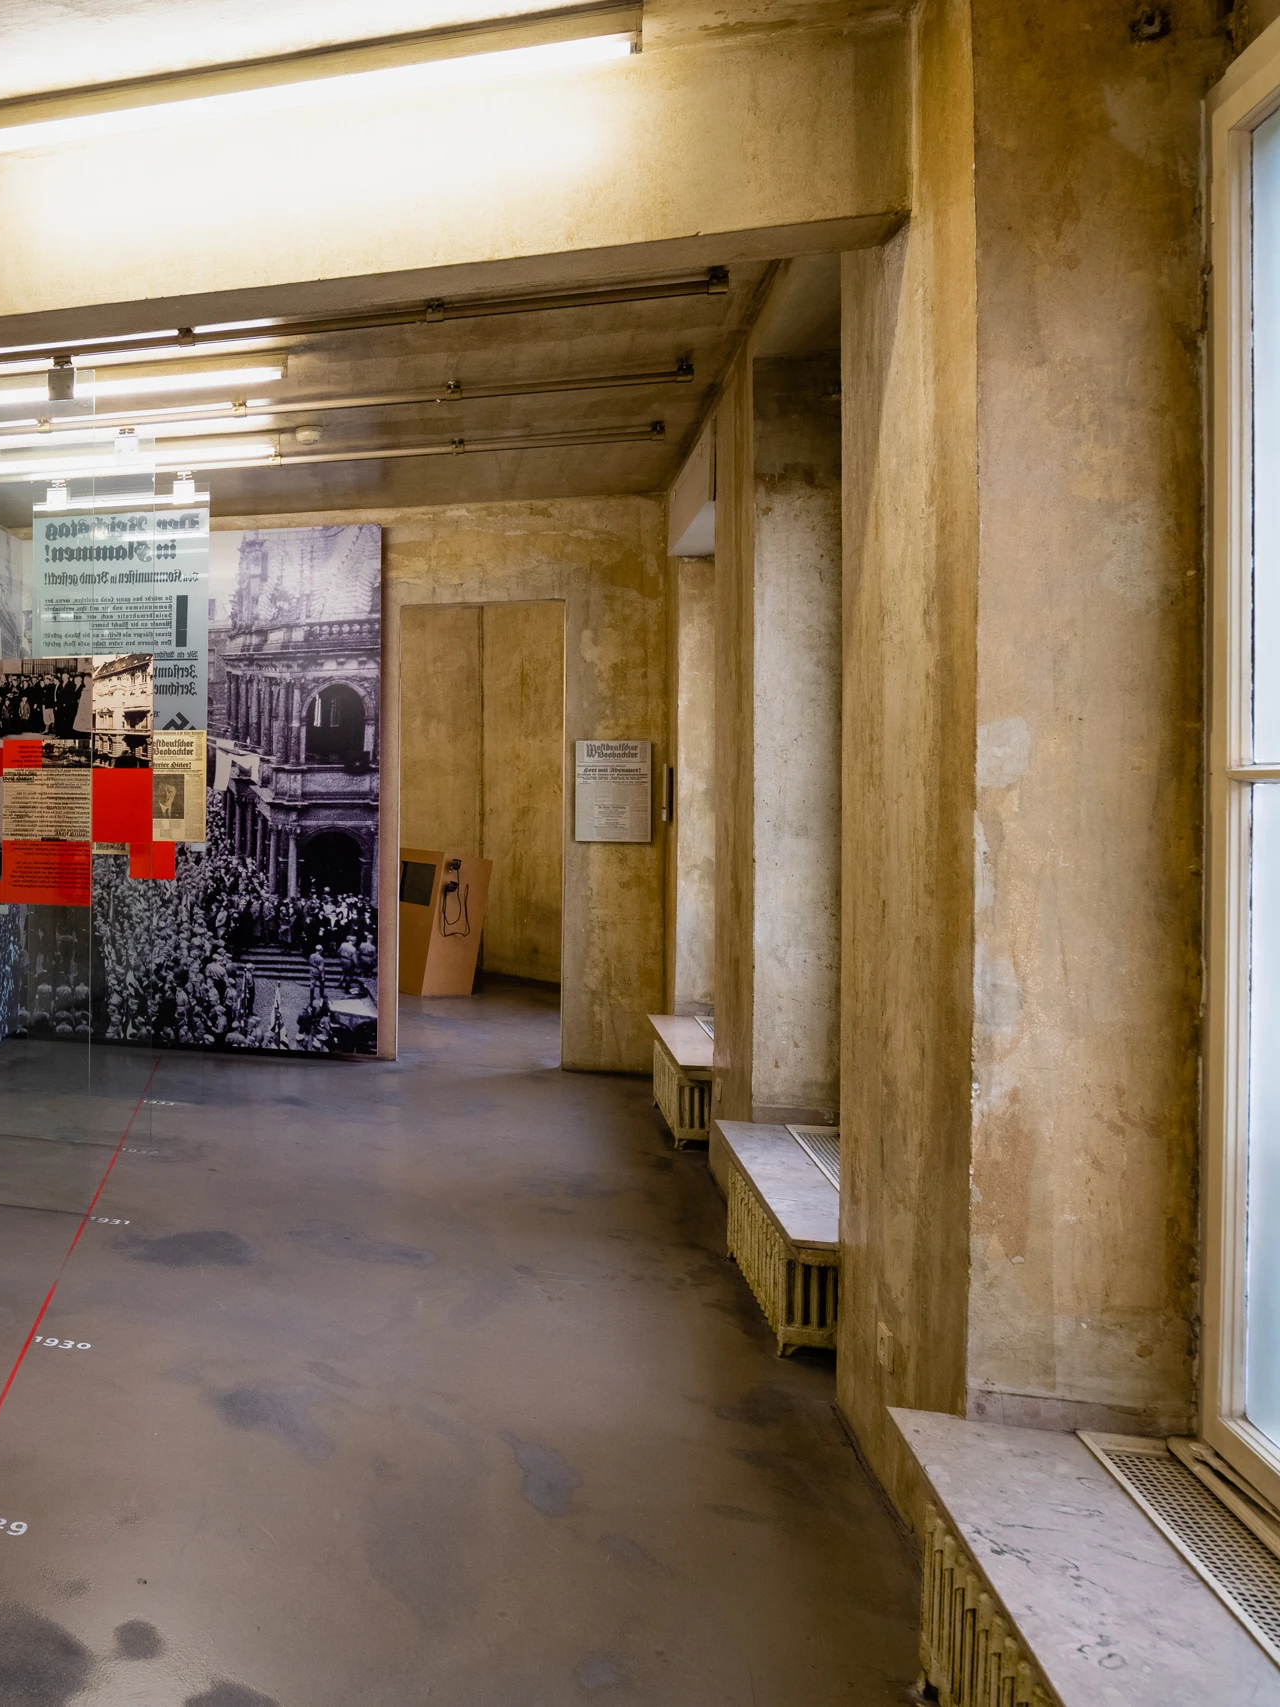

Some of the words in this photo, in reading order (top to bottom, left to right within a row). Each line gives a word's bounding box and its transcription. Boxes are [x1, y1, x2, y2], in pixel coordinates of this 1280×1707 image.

[153, 739, 194, 748] estdeutscher
[90, 1216, 130, 1225] 1931
[35, 1336, 91, 1350] 1930
